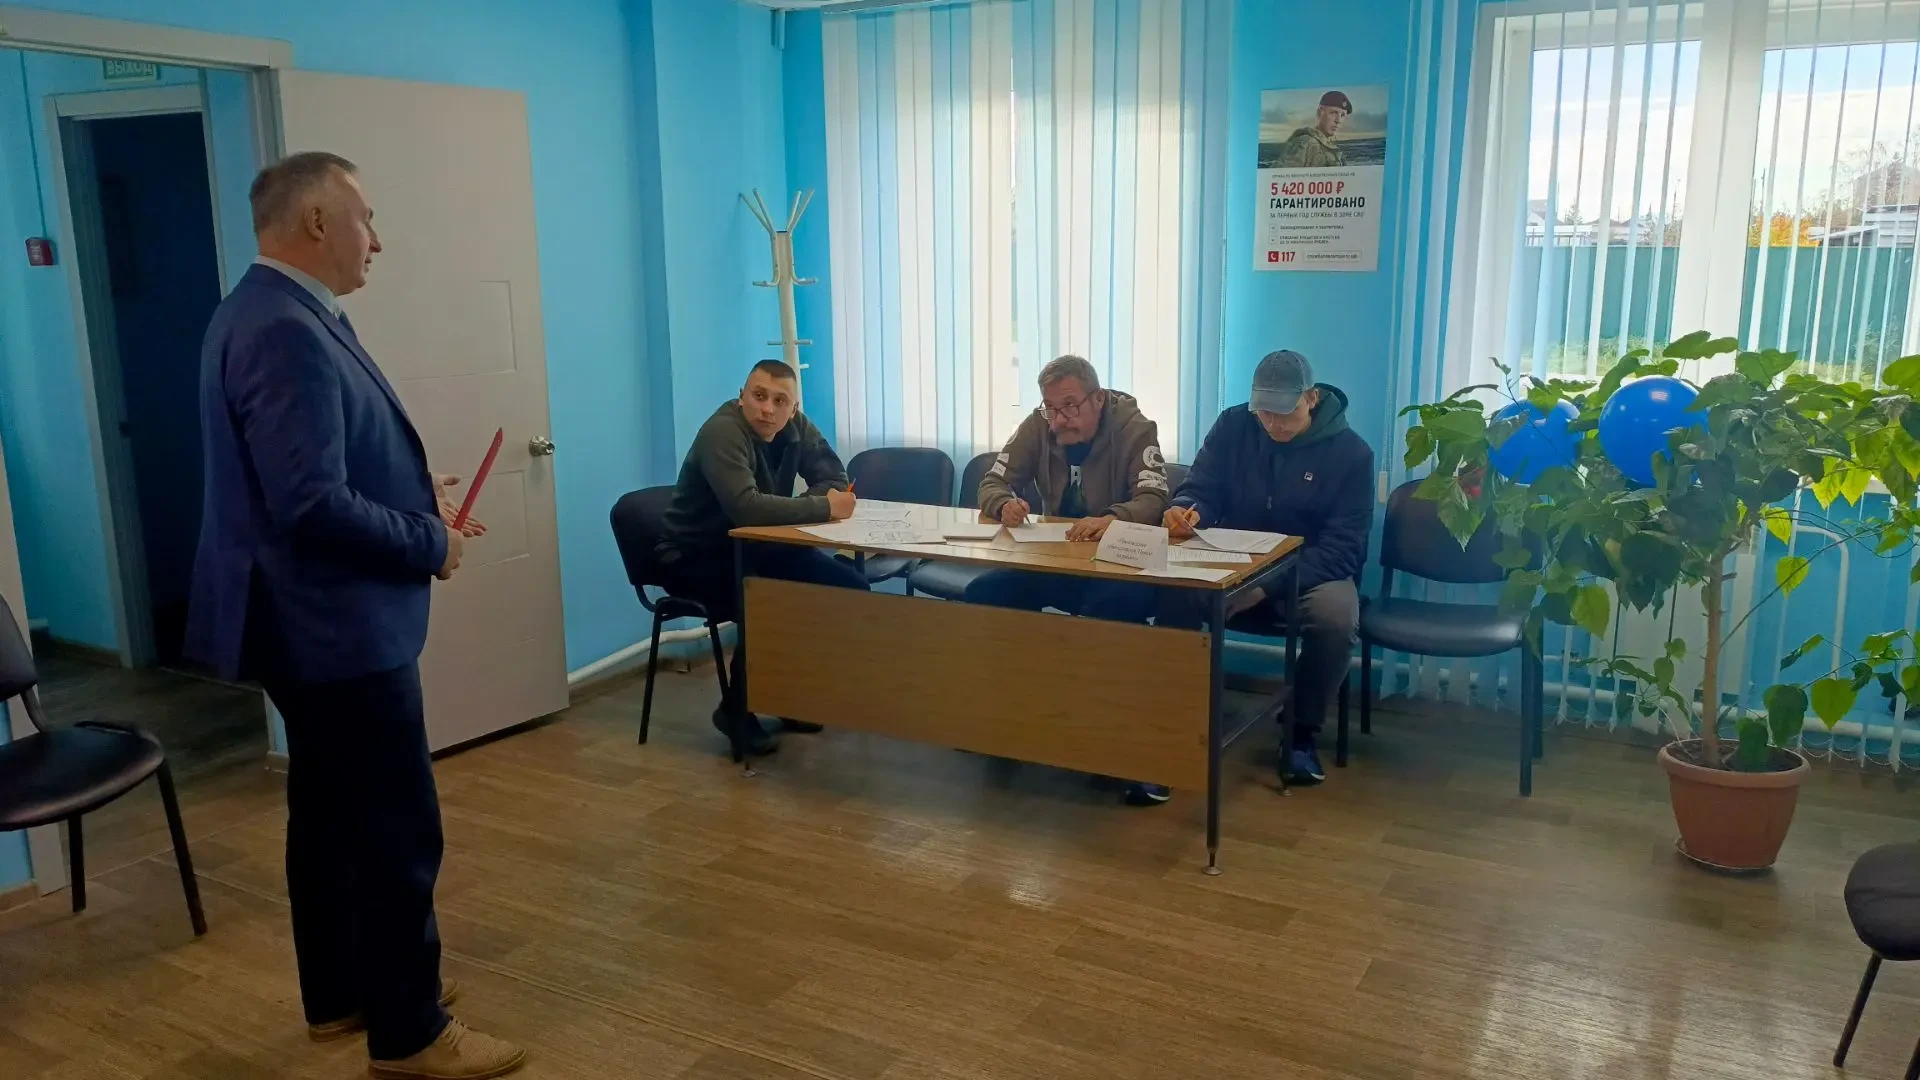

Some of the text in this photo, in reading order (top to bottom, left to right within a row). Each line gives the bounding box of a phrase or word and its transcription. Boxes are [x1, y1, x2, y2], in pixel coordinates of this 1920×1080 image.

[107, 60, 154, 77] ВЫХОД
[1271, 182, 1278, 195] 5
[1281, 182, 1304, 195] 420
[1308, 181, 1333, 195] 000
[1270, 196, 1366, 209] ГАРАНТИРОВАНО
[1281, 251, 1296, 262] 117
